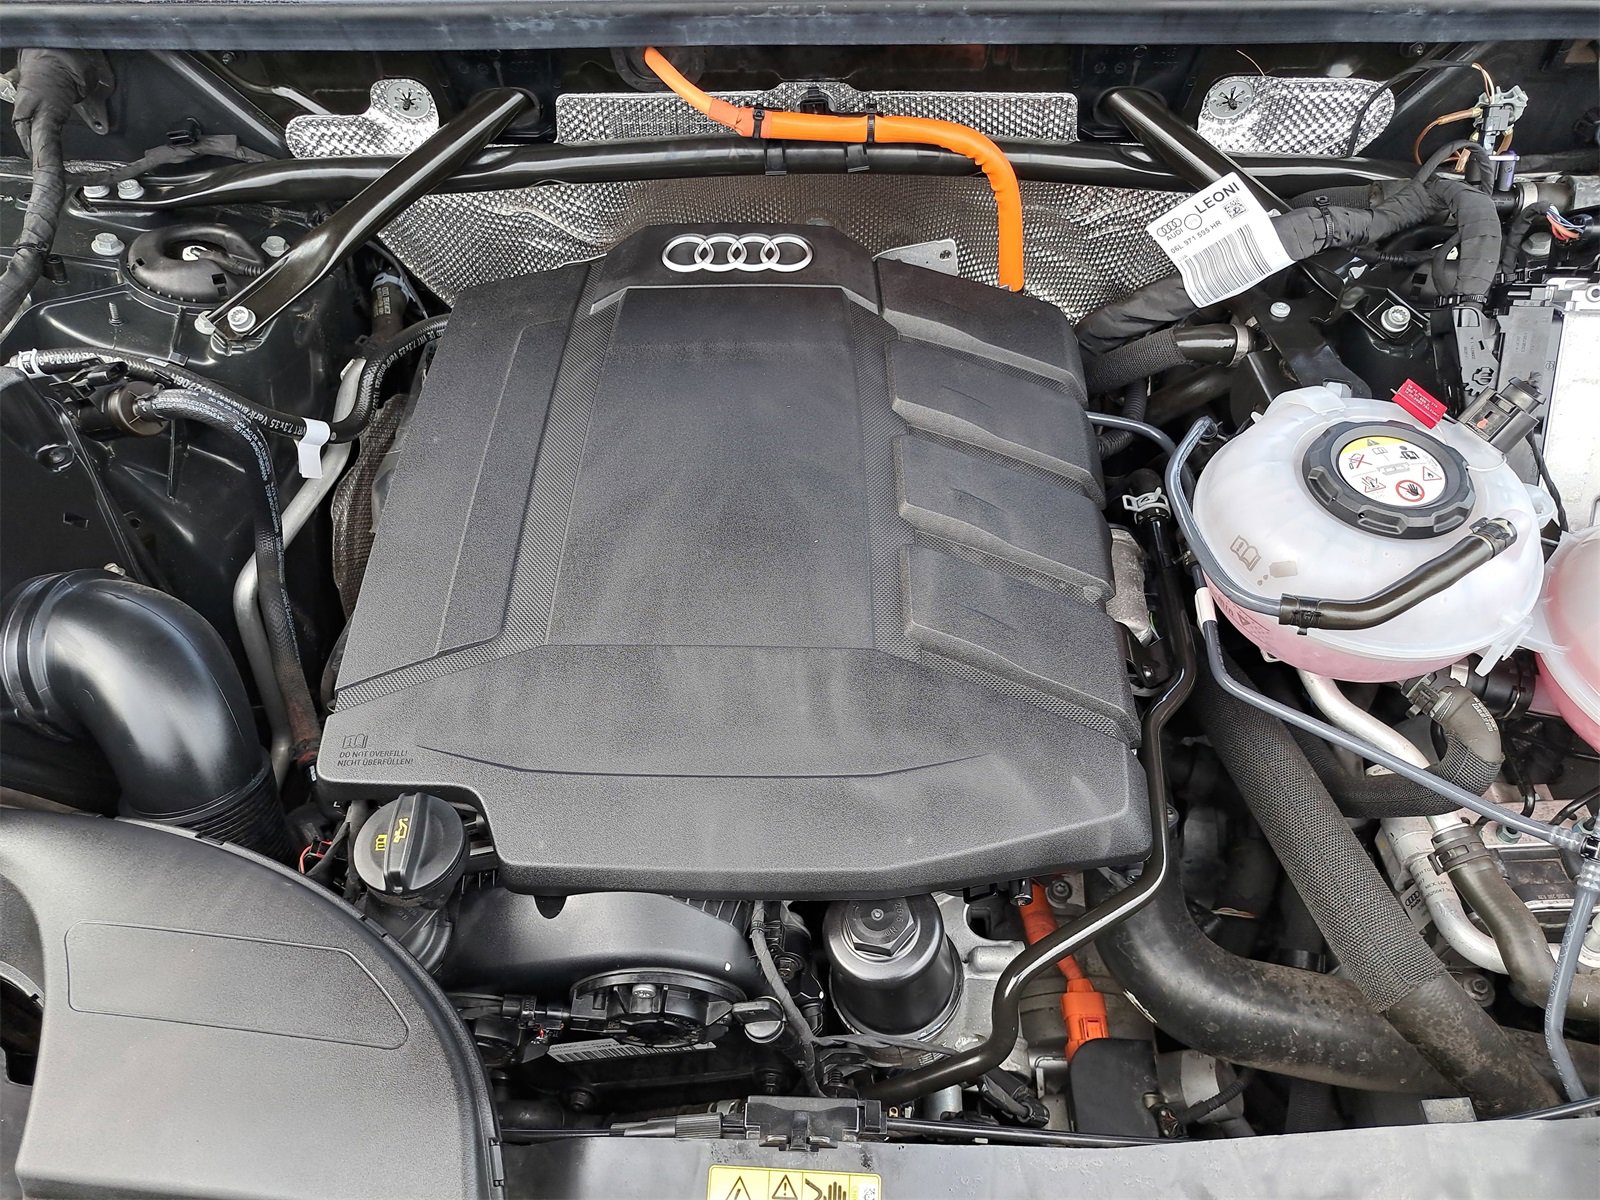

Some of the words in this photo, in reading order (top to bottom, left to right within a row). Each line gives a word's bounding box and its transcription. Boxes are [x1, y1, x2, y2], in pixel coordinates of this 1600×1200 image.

[1194, 182, 1240, 214] LEONI
[1209, 220, 1222, 230] HR
[1167, 228, 1183, 241] AUDI
